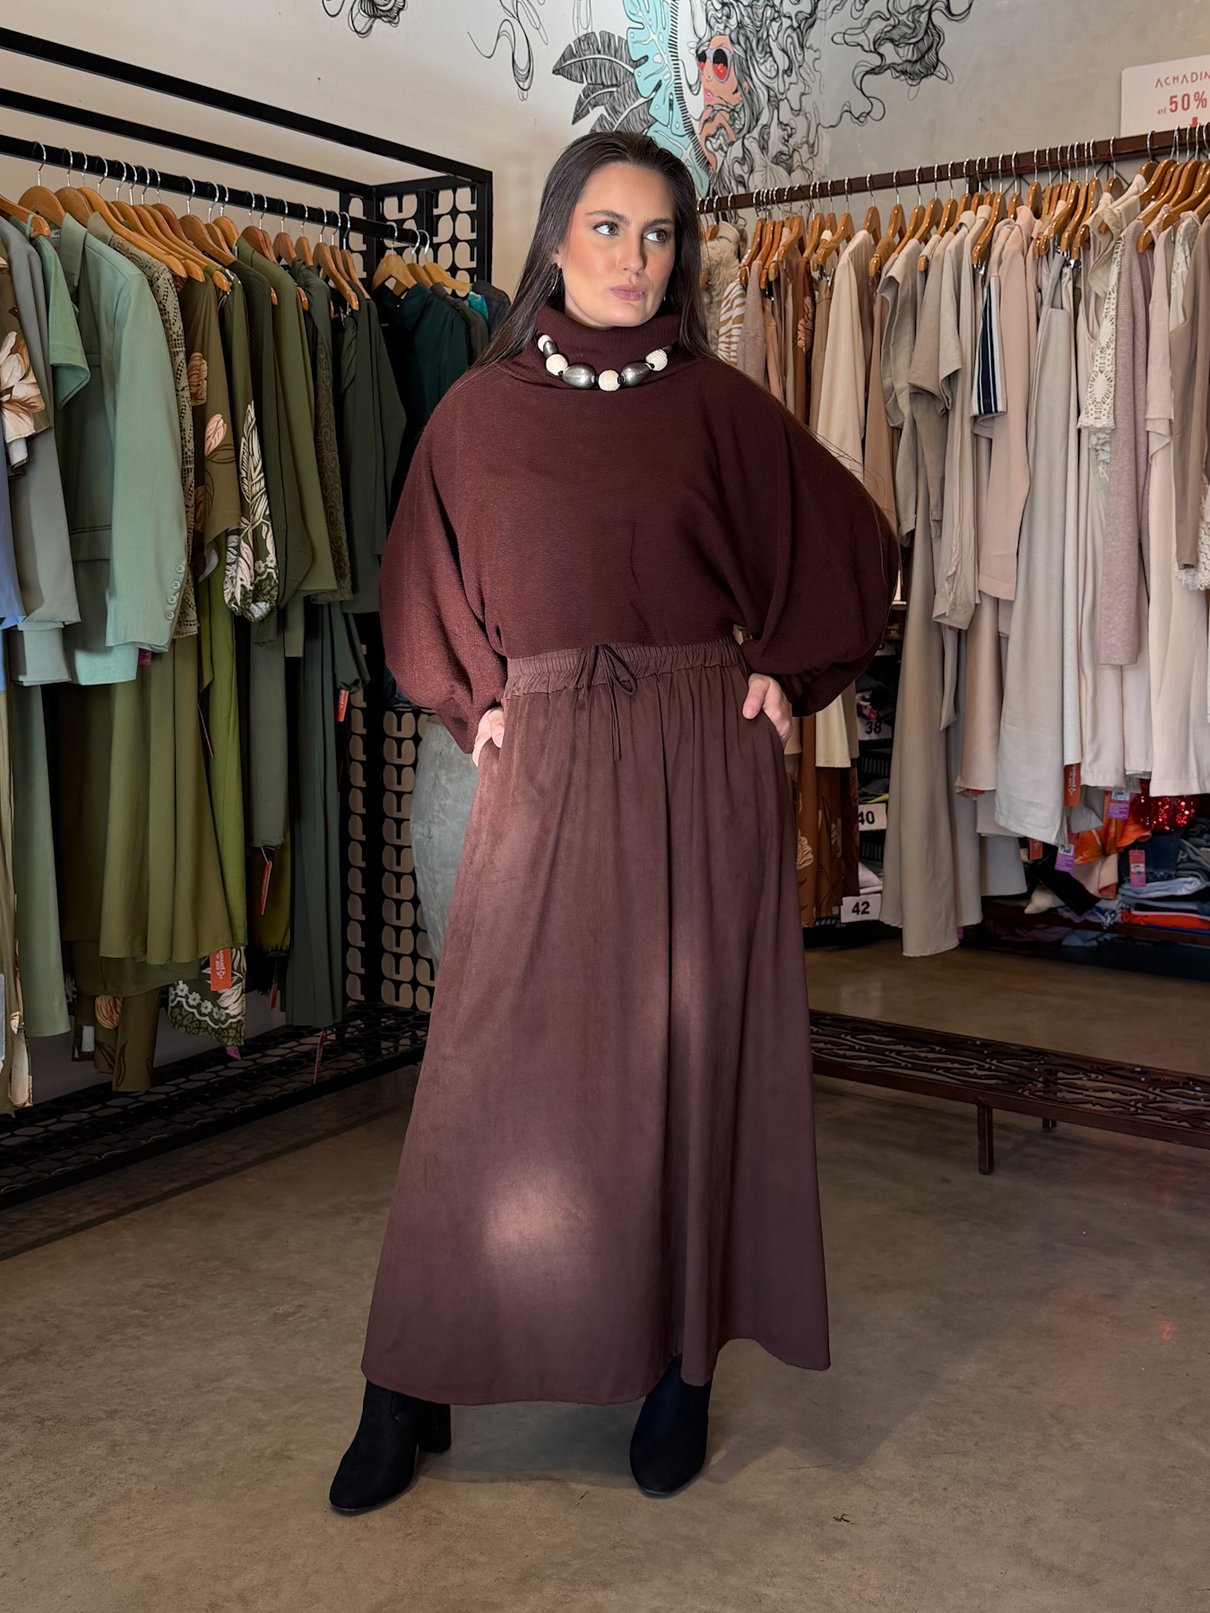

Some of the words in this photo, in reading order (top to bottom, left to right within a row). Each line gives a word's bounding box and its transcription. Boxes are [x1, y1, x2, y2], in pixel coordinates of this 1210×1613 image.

[1169, 91, 1207, 113] 50%
[865, 720, 882, 735] 38
[856, 810, 875, 825] 40
[851, 901, 870, 915] 42
